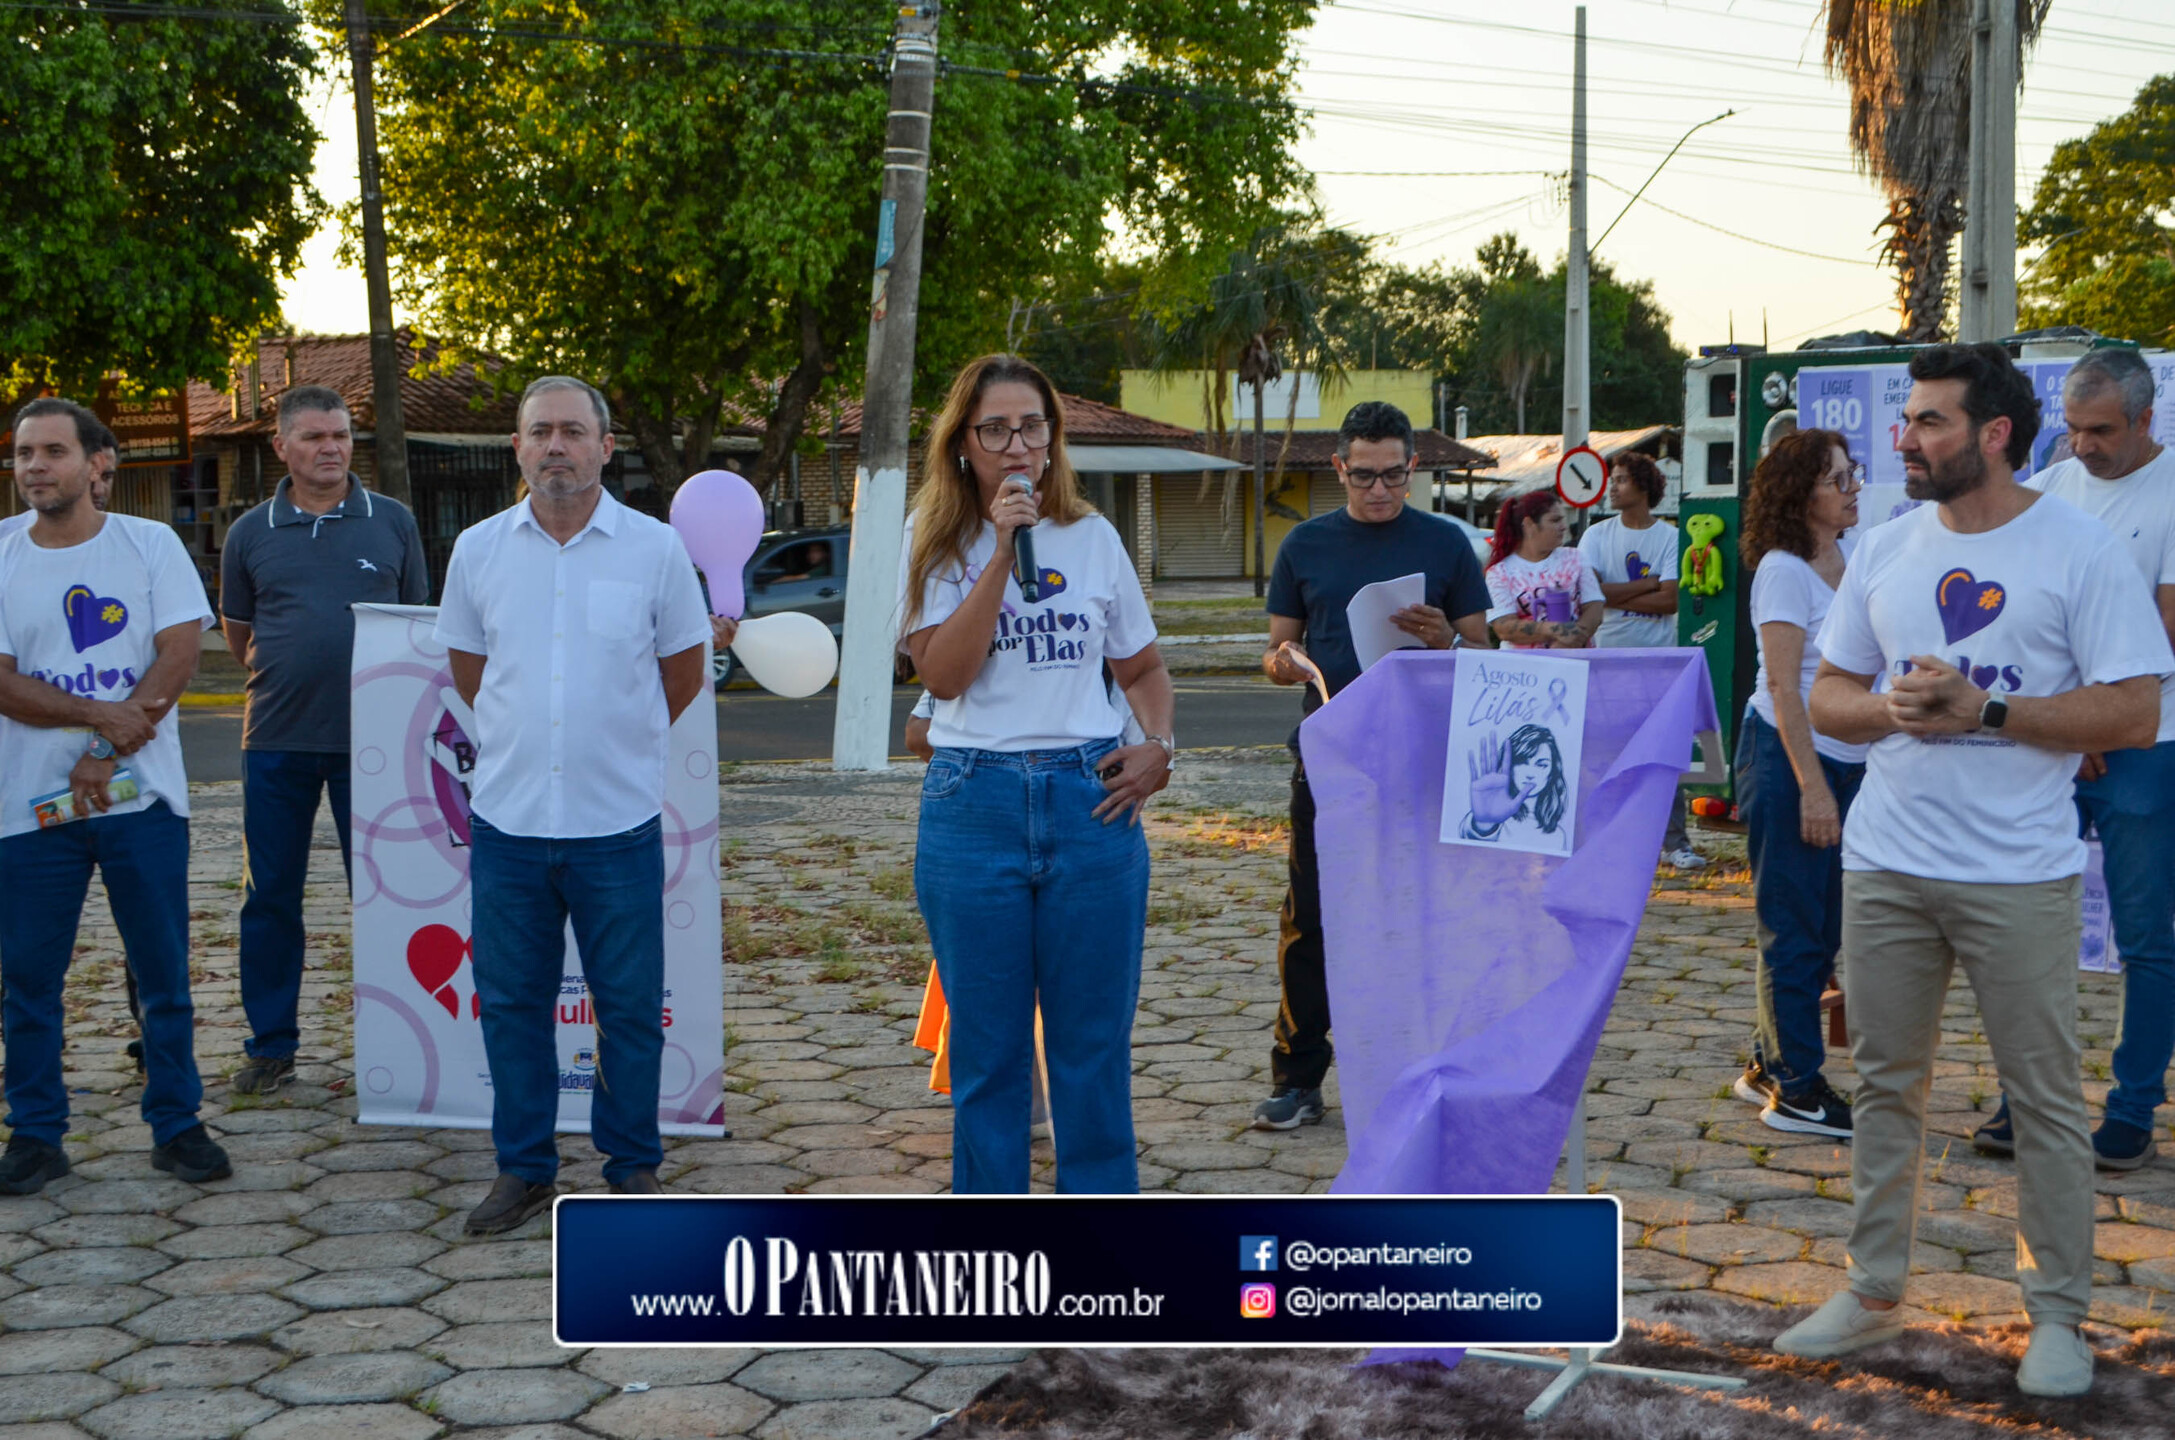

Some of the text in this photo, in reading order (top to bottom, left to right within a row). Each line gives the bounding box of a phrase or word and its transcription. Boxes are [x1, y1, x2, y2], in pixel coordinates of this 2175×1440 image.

[1820, 379, 1853, 396] LIGUE
[1887, 378, 1900, 390] EM
[165, 401, 172, 411] E
[1811, 398, 1862, 431] 180
[110, 414, 179, 427] ACESSÓRIOS
[1025, 634, 1086, 664] Elas
[1472, 662, 1538, 688] Agosto
[1468, 688, 1541, 726] Lilás
